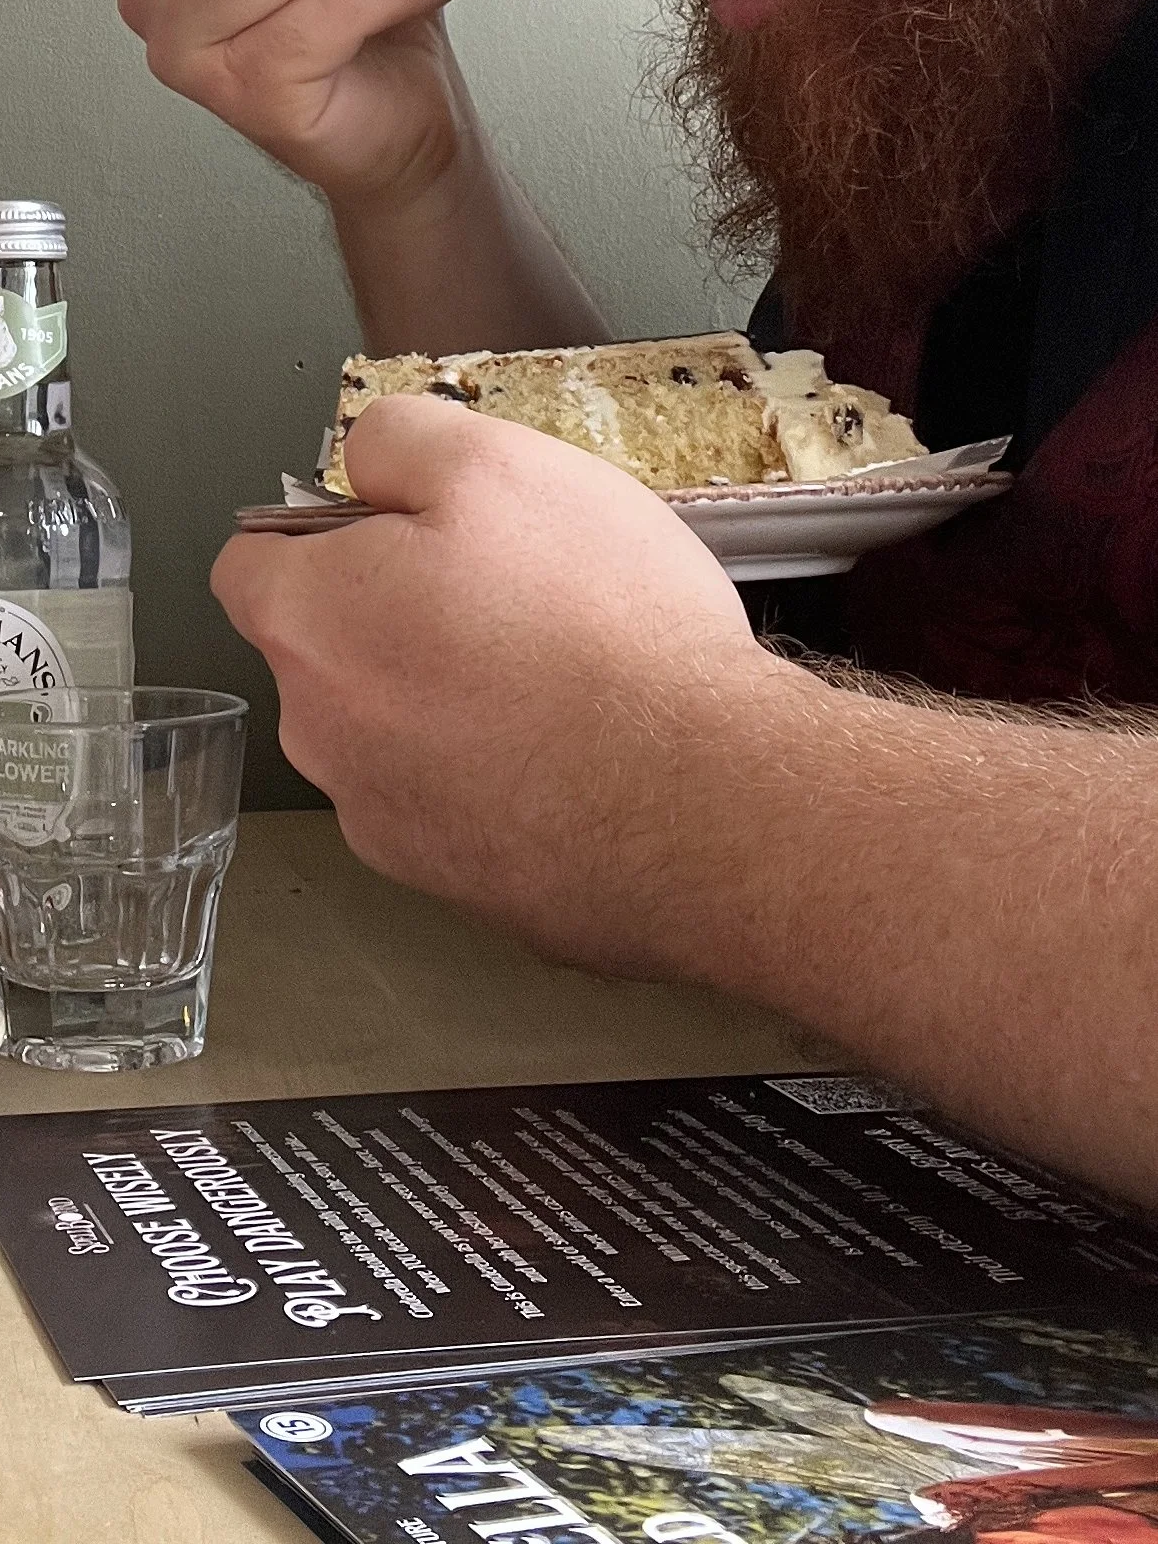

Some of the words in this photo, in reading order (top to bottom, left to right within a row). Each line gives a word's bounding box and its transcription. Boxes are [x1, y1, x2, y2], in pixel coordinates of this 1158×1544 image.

[21, 327, 53, 344] 1905
[738, 1114, 784, 1131] play
[777, 1139, 833, 1166] hands
[83, 1153, 174, 1215] WISELY
[326, 1178, 347, 1190] the
[822, 1168, 880, 1189] your
[152, 1130, 301, 1250] DANGEROUSLY
[335, 1190, 368, 1206] path
[861, 1191, 890, 1201] in
[407, 1200, 438, 1219] never
[880, 1203, 909, 1212] is
[339, 1231, 361, 1244] the
[374, 1228, 408, 1252] decide
[484, 1236, 509, 1249] her
[904, 1215, 972, 1251] destiny
[349, 1244, 370, 1252] is
[453, 1242, 473, 1252] as
[552, 1246, 578, 1254] of
[134, 1219, 256, 1305] CHOOSE
[354, 1252, 394, 1277] Retold
[497, 1249, 528, 1266] with
[566, 1255, 605, 1276] world
[464, 1253, 514, 1291] Cinderella
[514, 1267, 547, 1282] and
[963, 1254, 1023, 1283] Their
[417, 1270, 450, 1293] where
[259, 1259, 379, 1326] PLAY
[384, 1278, 432, 1318] Cinderella
[504, 1291, 526, 1300] is
[604, 1284, 641, 1306] Enter
[514, 1300, 544, 1318] This
